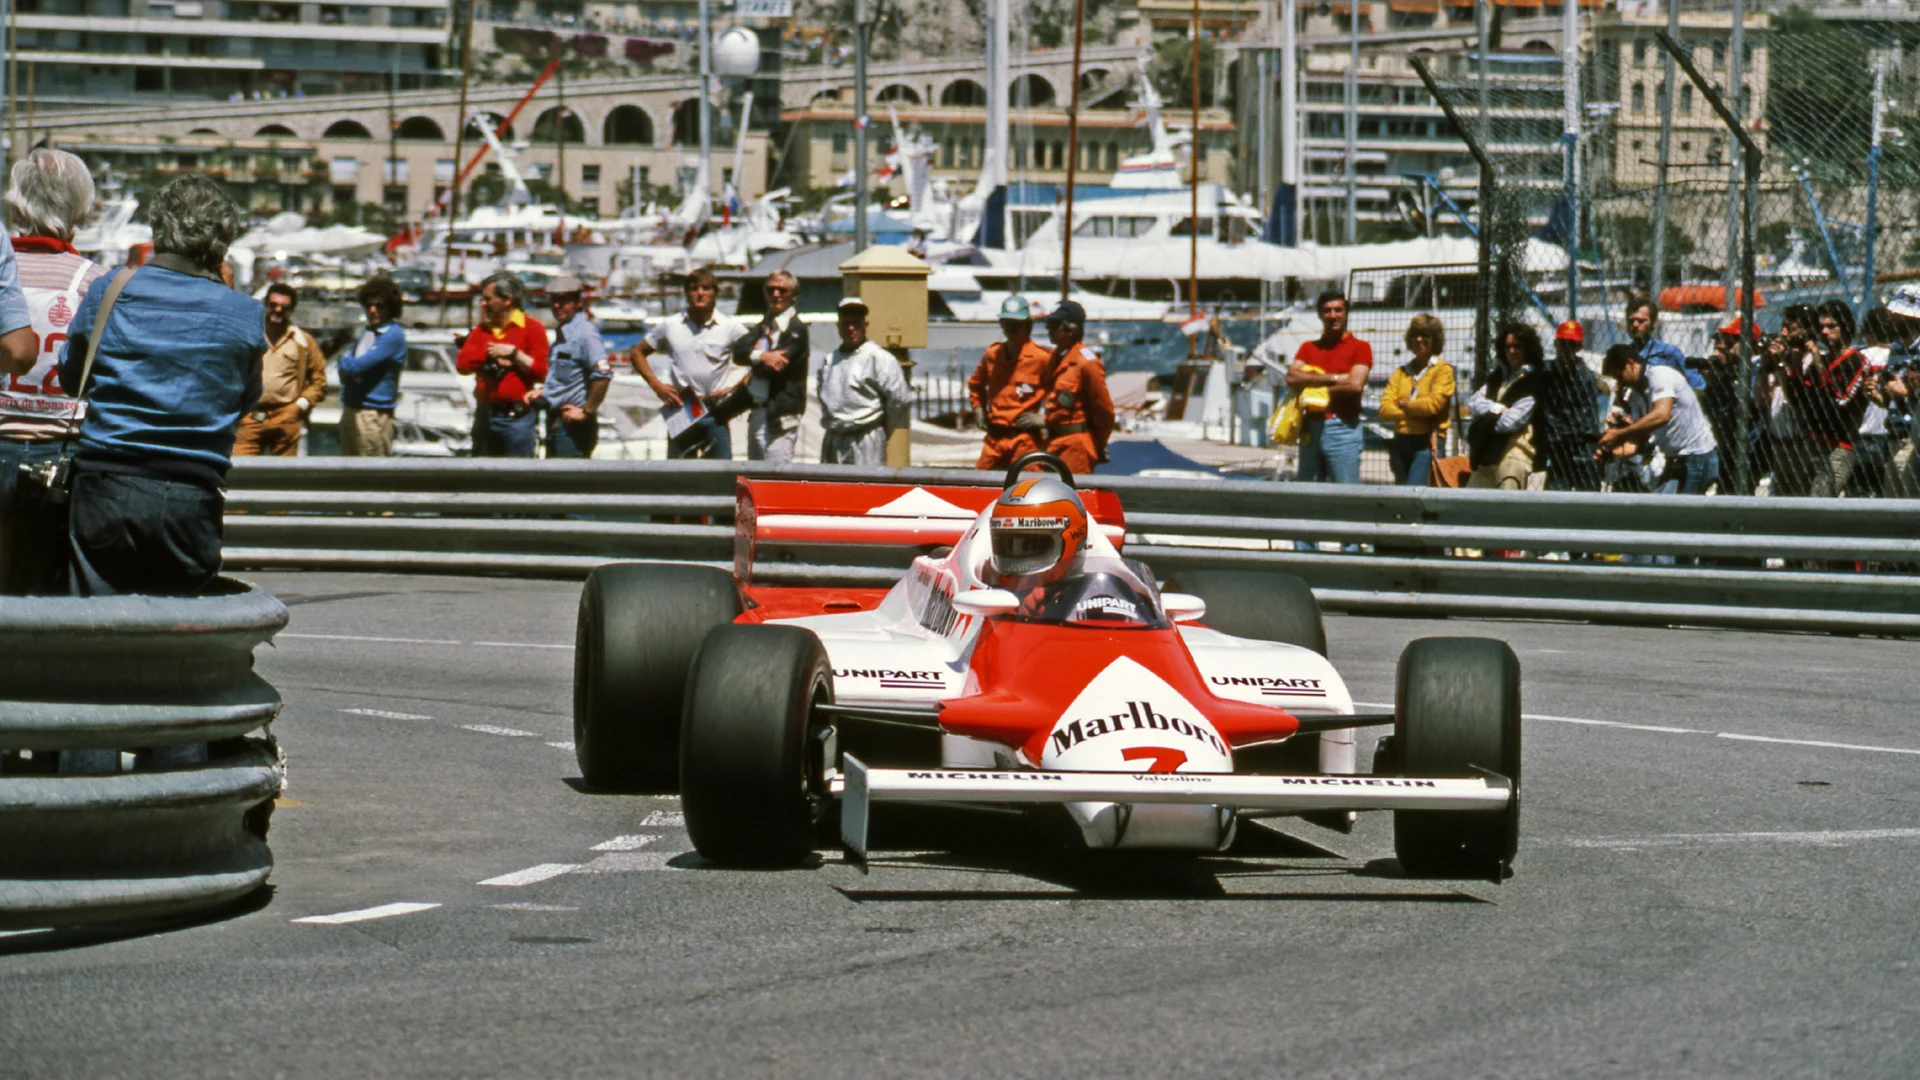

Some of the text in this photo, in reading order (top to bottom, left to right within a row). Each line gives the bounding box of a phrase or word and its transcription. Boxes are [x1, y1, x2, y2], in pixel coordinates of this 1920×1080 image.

[22, 398, 33, 408] de
[37, 399, 78, 410] Monaco
[1018, 518, 1055, 528] Marlboro
[1076, 597, 1137, 613] UNIPART
[832, 669, 944, 680] UNIPART
[1210, 676, 1321, 688] UNIPART
[1051, 701, 1227, 758] Marlboro
[907, 772, 1063, 781] MICHELIN
[1132, 774, 1213, 783] Valvoline
[1281, 778, 1436, 788] MICHELIN
